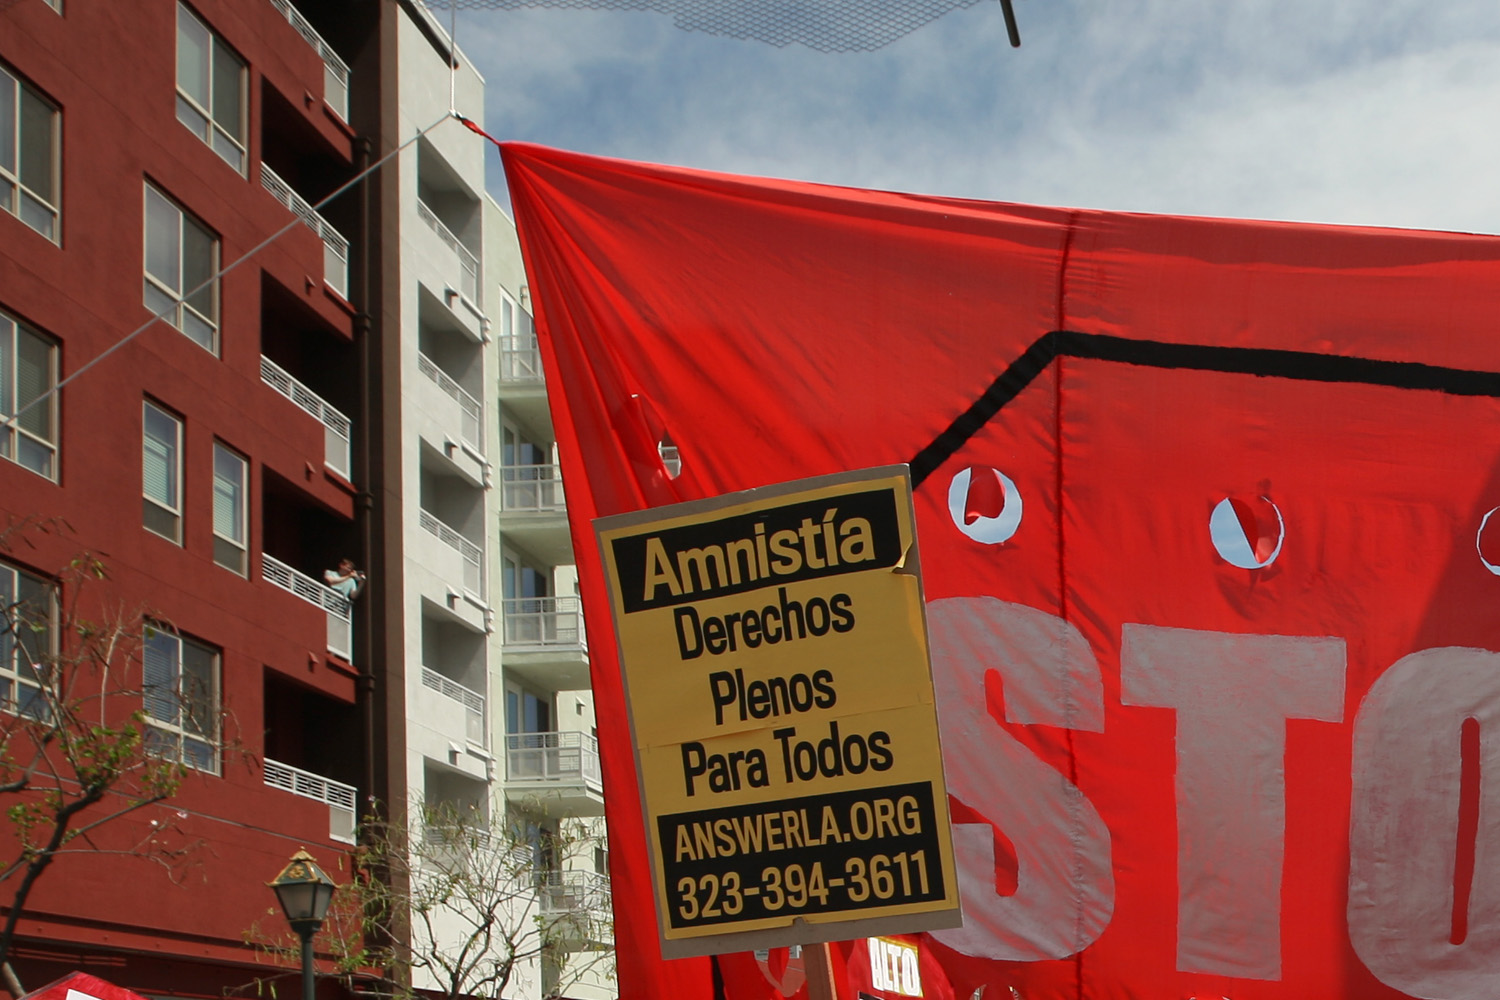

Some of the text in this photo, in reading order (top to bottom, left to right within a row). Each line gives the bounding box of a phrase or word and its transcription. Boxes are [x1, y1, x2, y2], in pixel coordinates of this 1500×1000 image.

[643, 508, 876, 601] Amnistía
[673, 587, 855, 660] Derechos
[709, 667, 836, 725] Plenos
[681, 721, 894, 796] Para Todos
[675, 795, 922, 862] ANSWERLA.ORG
[677, 850, 930, 920] 323-394-3611
[868, 936, 922, 996] ALTO
